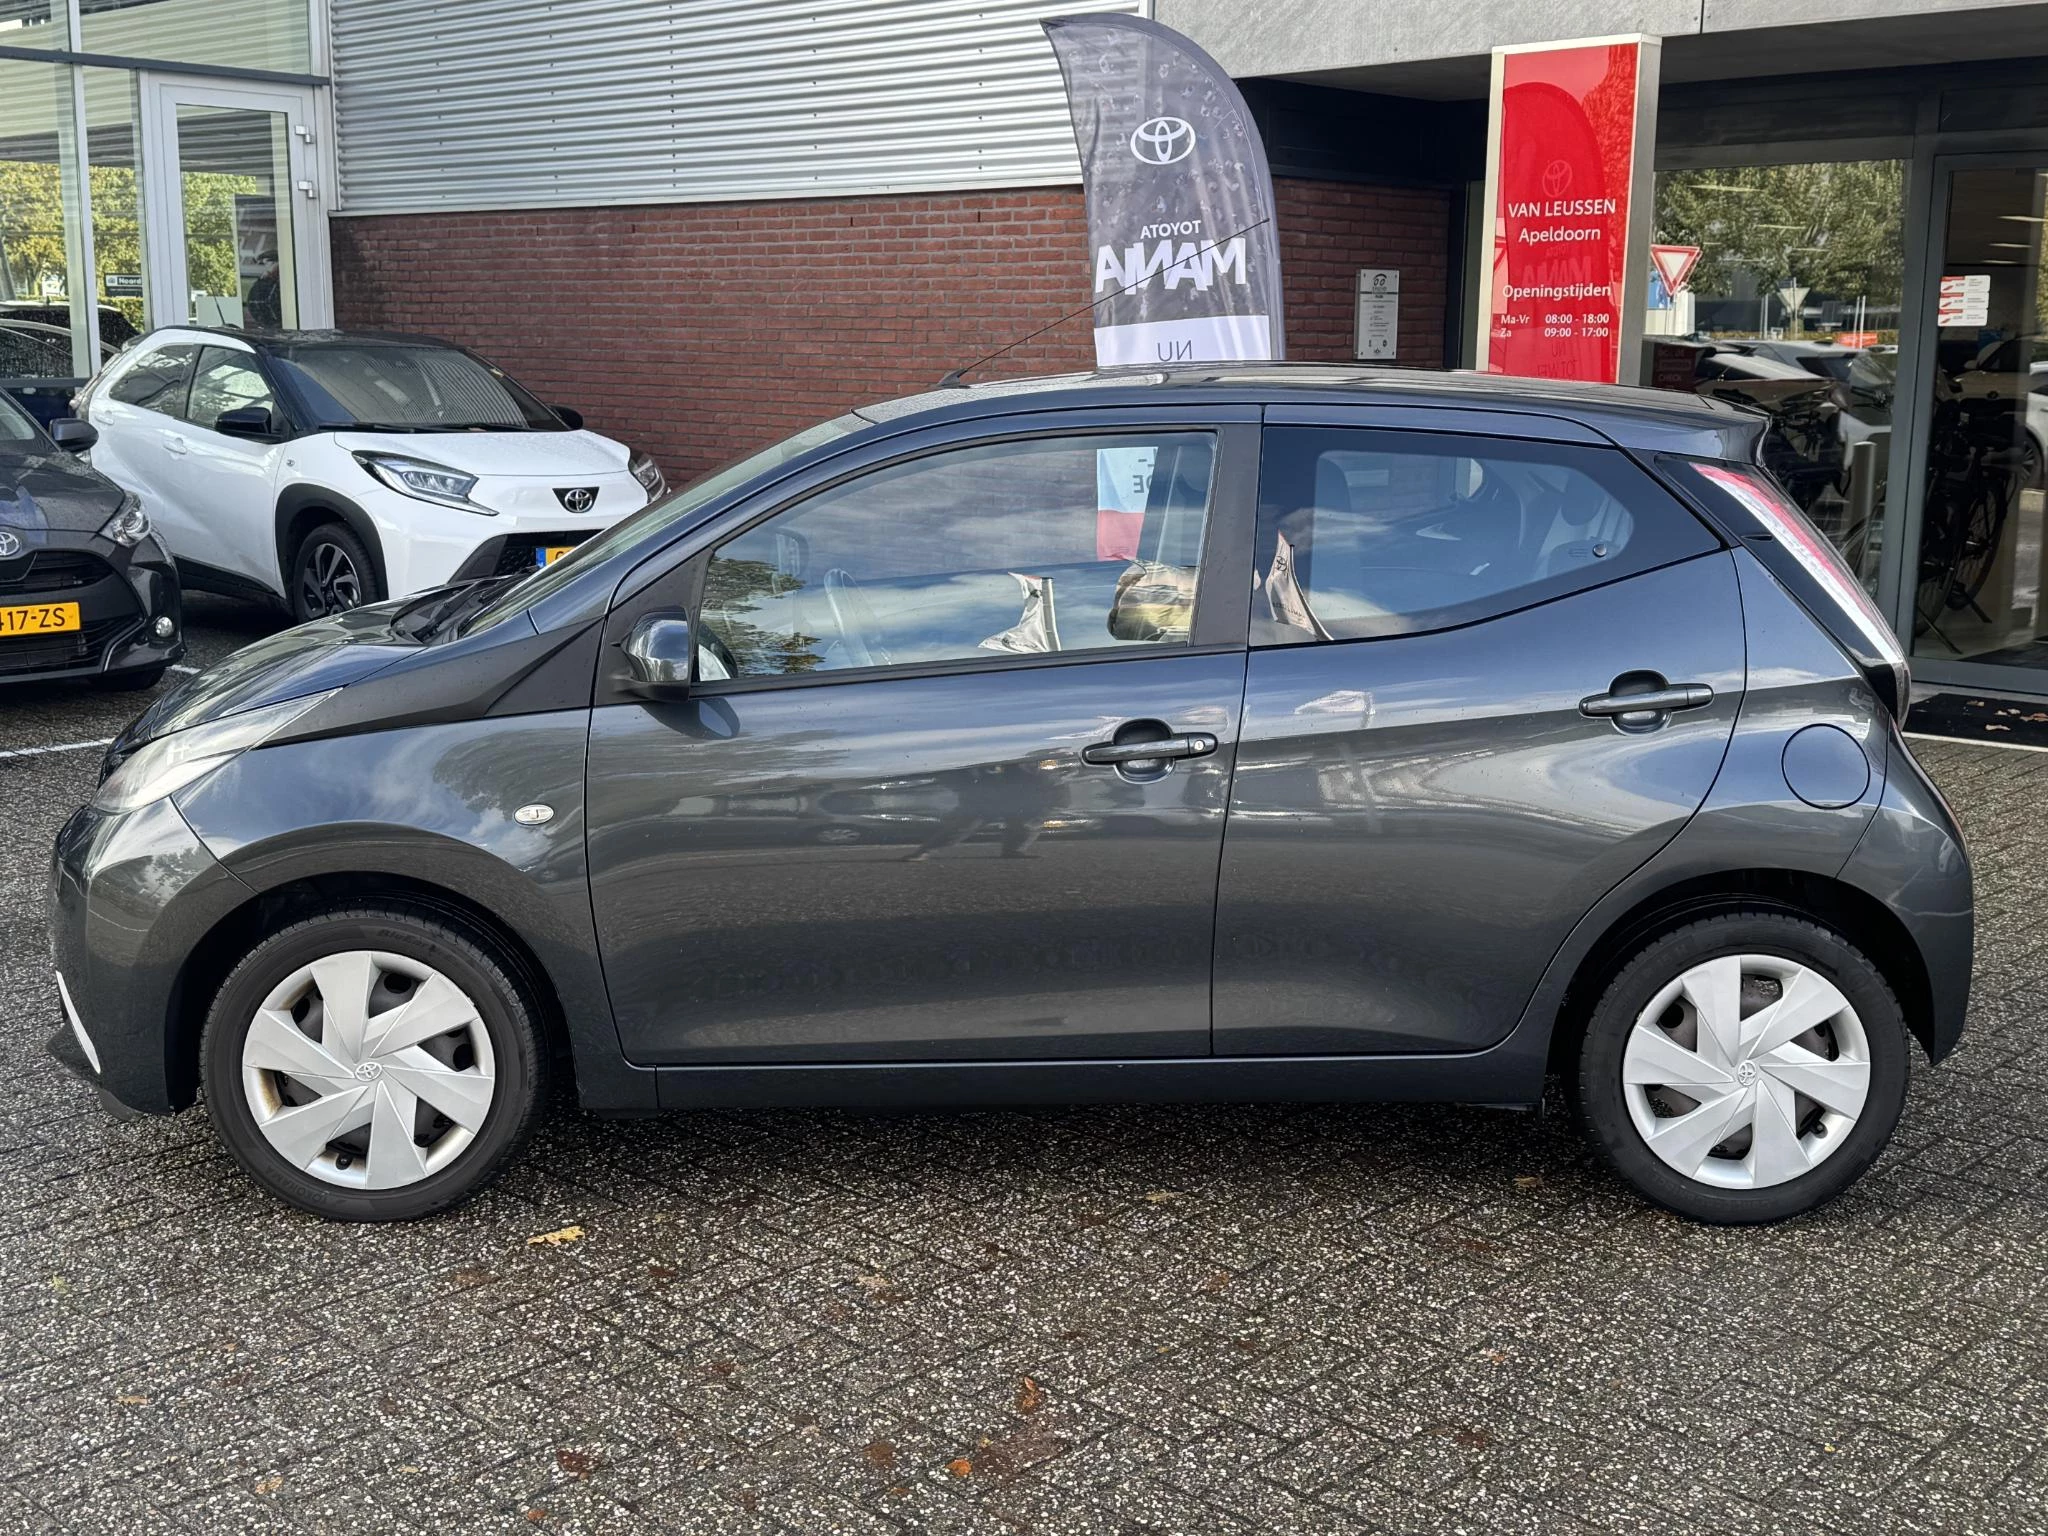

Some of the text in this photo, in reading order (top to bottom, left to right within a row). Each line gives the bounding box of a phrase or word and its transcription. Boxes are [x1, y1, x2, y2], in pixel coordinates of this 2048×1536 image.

[1508, 198, 1617, 218] VAN LEUSSEN
[1518, 226, 1601, 246] Apeldoorn
[1502, 283, 1612, 301] Openingstijden
[1501, 314, 1530, 324] Ma-Vr
[1545, 314, 1573, 324] 08:00
[1582, 313, 1610, 324] 18:00
[1500, 328, 1512, 337] Za
[1544, 328, 1572, 337] 09:00
[1582, 327, 1609, 337] 17:00
